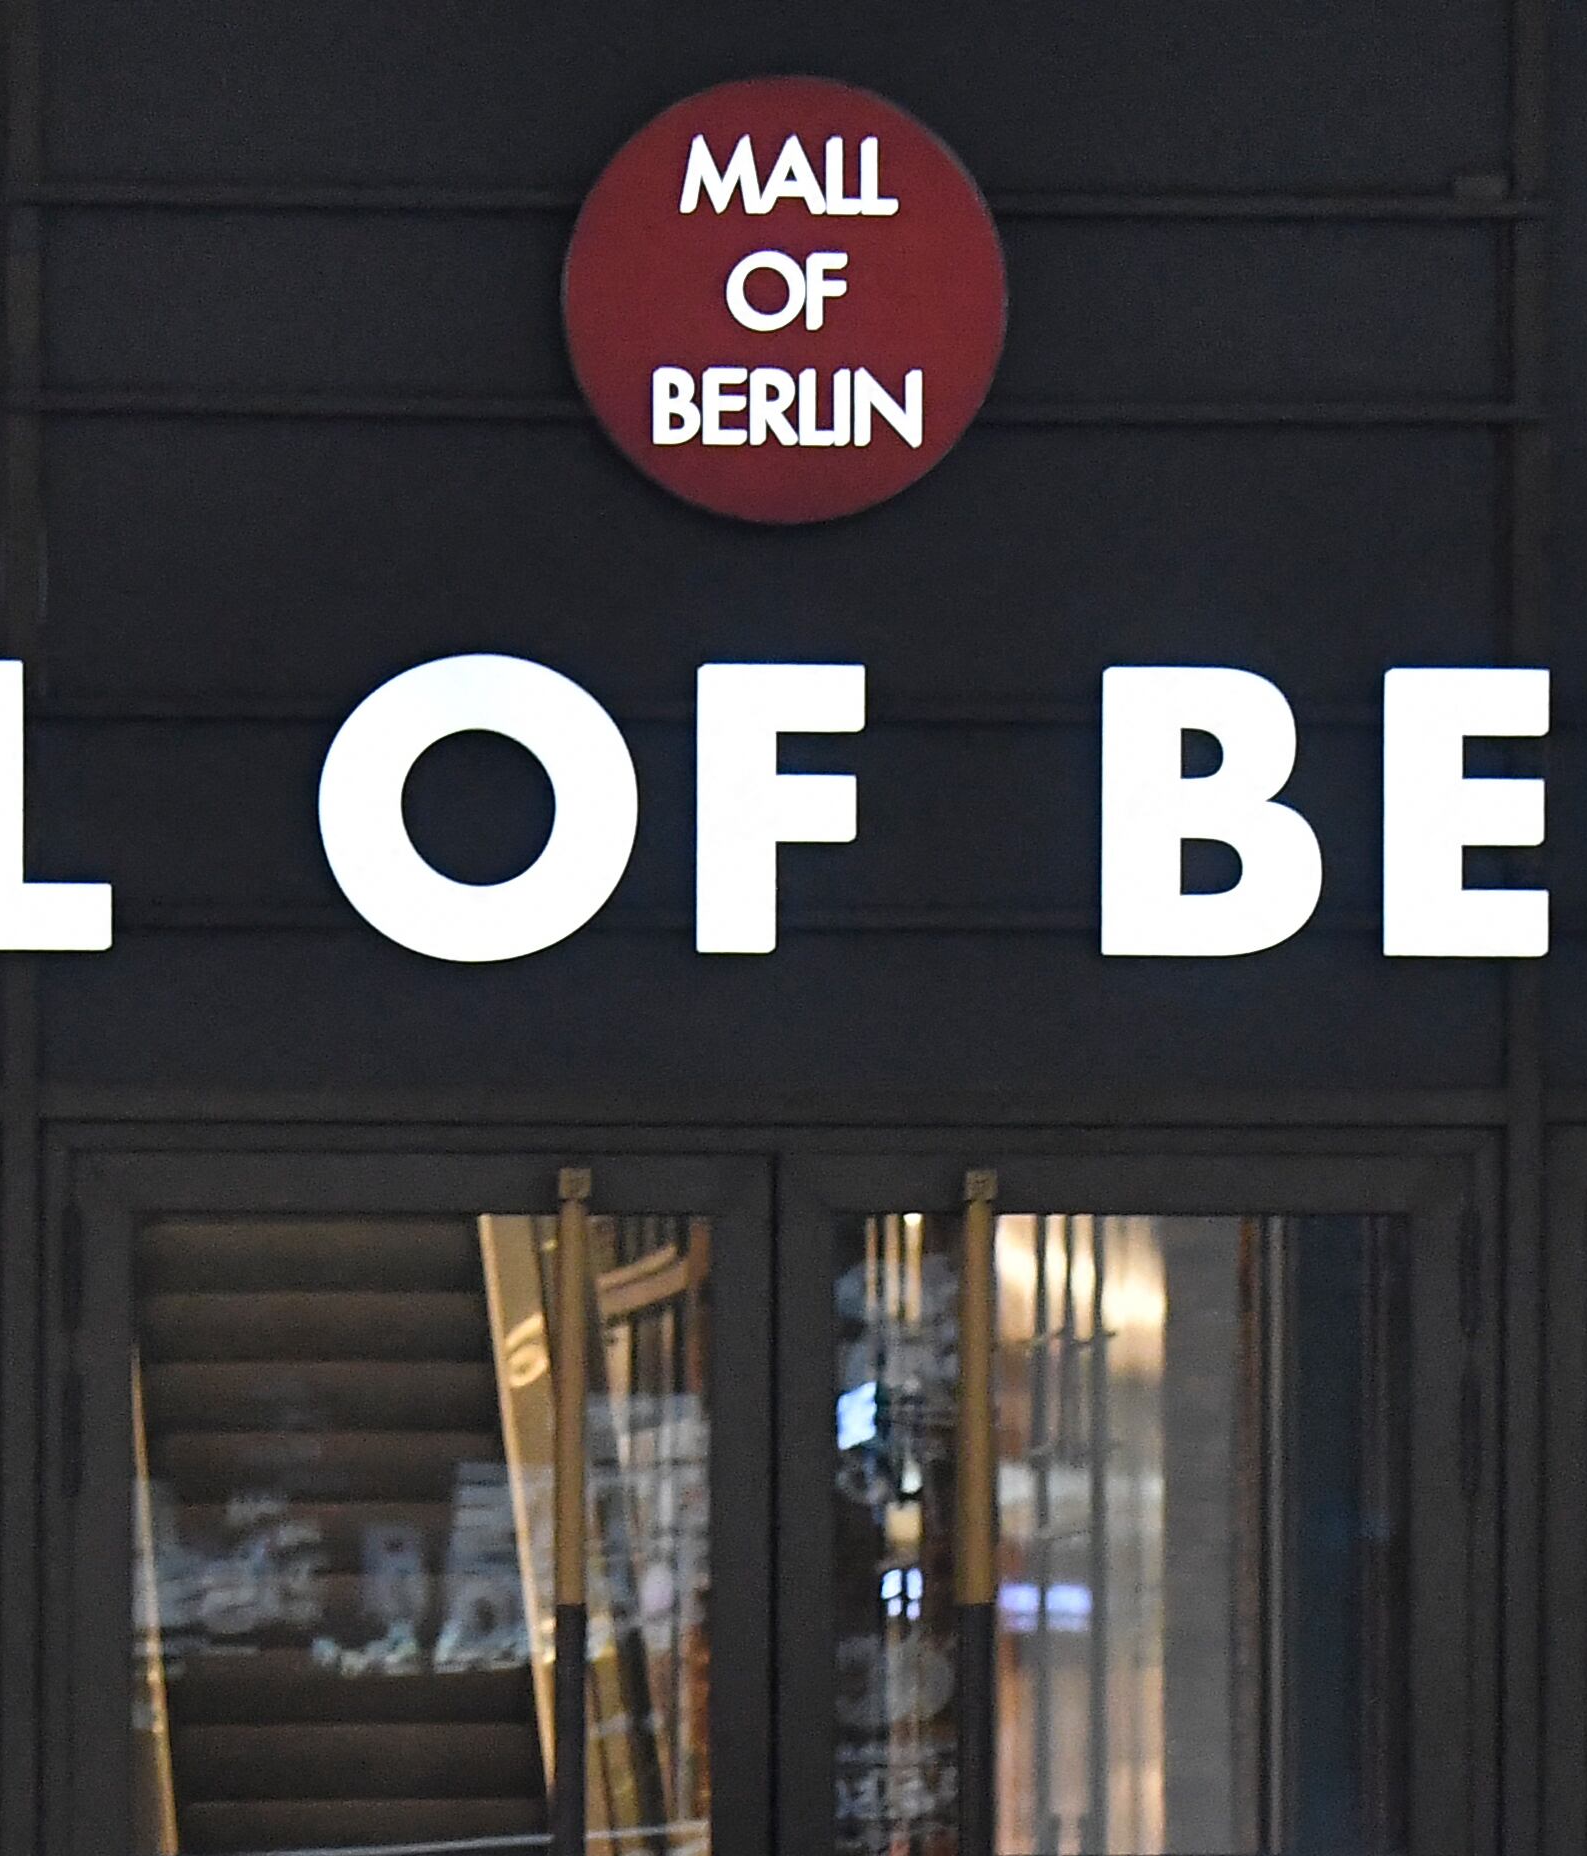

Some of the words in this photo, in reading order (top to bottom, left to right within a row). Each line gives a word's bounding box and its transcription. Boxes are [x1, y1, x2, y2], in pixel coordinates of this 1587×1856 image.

[680, 134, 899, 216] MALL
[726, 250, 848, 333] OF
[652, 367, 923, 449] BERLIN
[317, 653, 867, 963] OF
